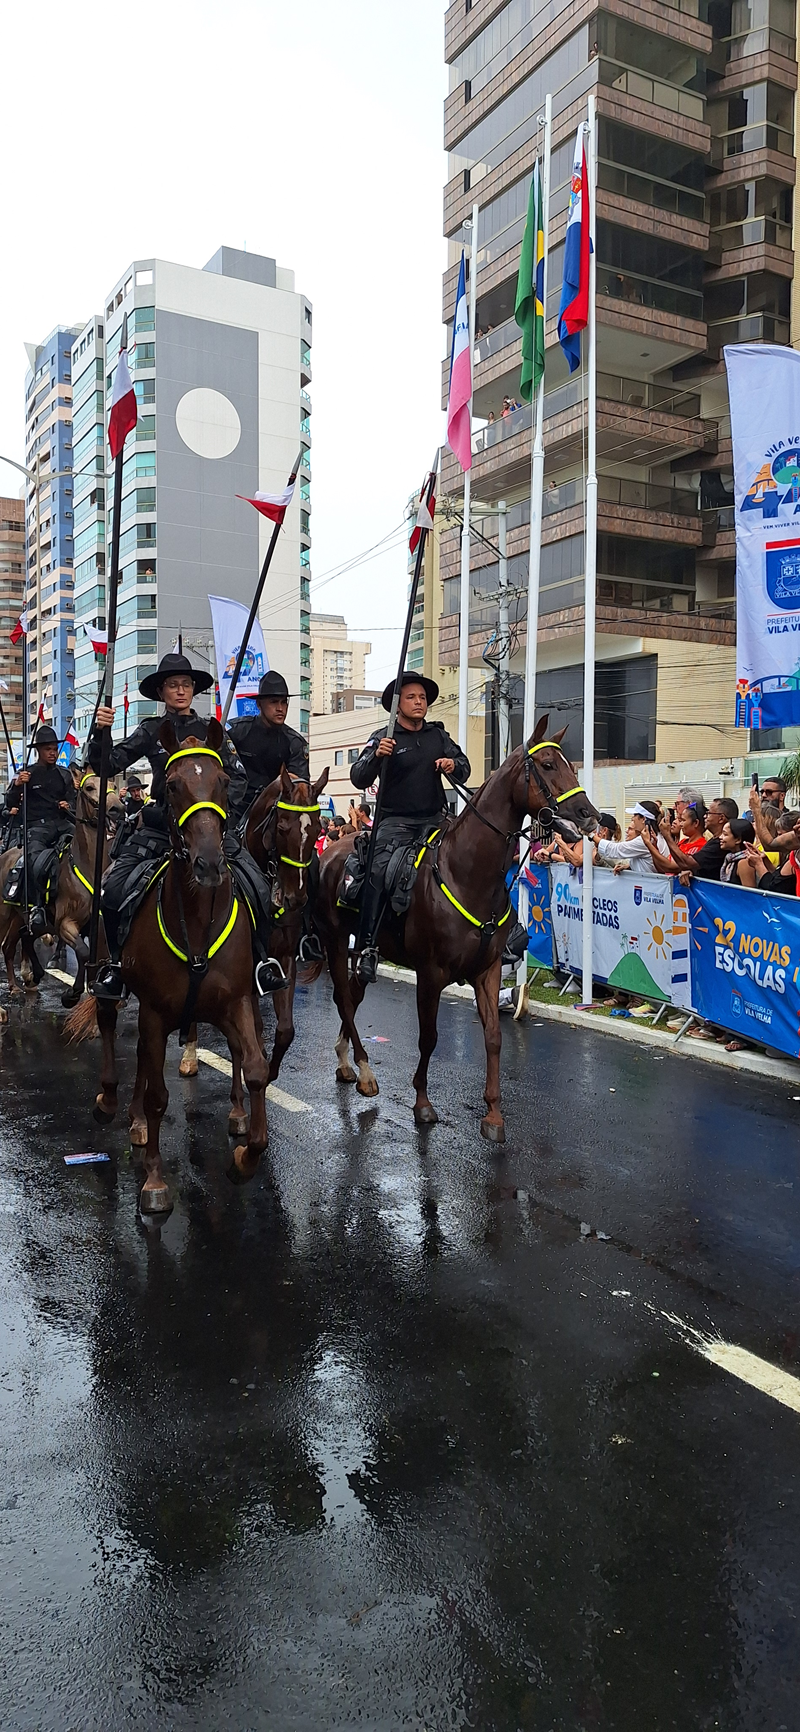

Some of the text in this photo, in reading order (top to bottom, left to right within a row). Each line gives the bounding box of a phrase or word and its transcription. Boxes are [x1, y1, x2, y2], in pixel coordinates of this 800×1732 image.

[764, 440, 785, 458] VILA
[766, 615, 800, 625] PREFEITU
[767, 624, 789, 634] VILA
[713, 917, 791, 967] 22 NOVAS
[714, 945, 786, 994] ESCOLAS
[744, 1006, 772, 1025] VILA VELHA
